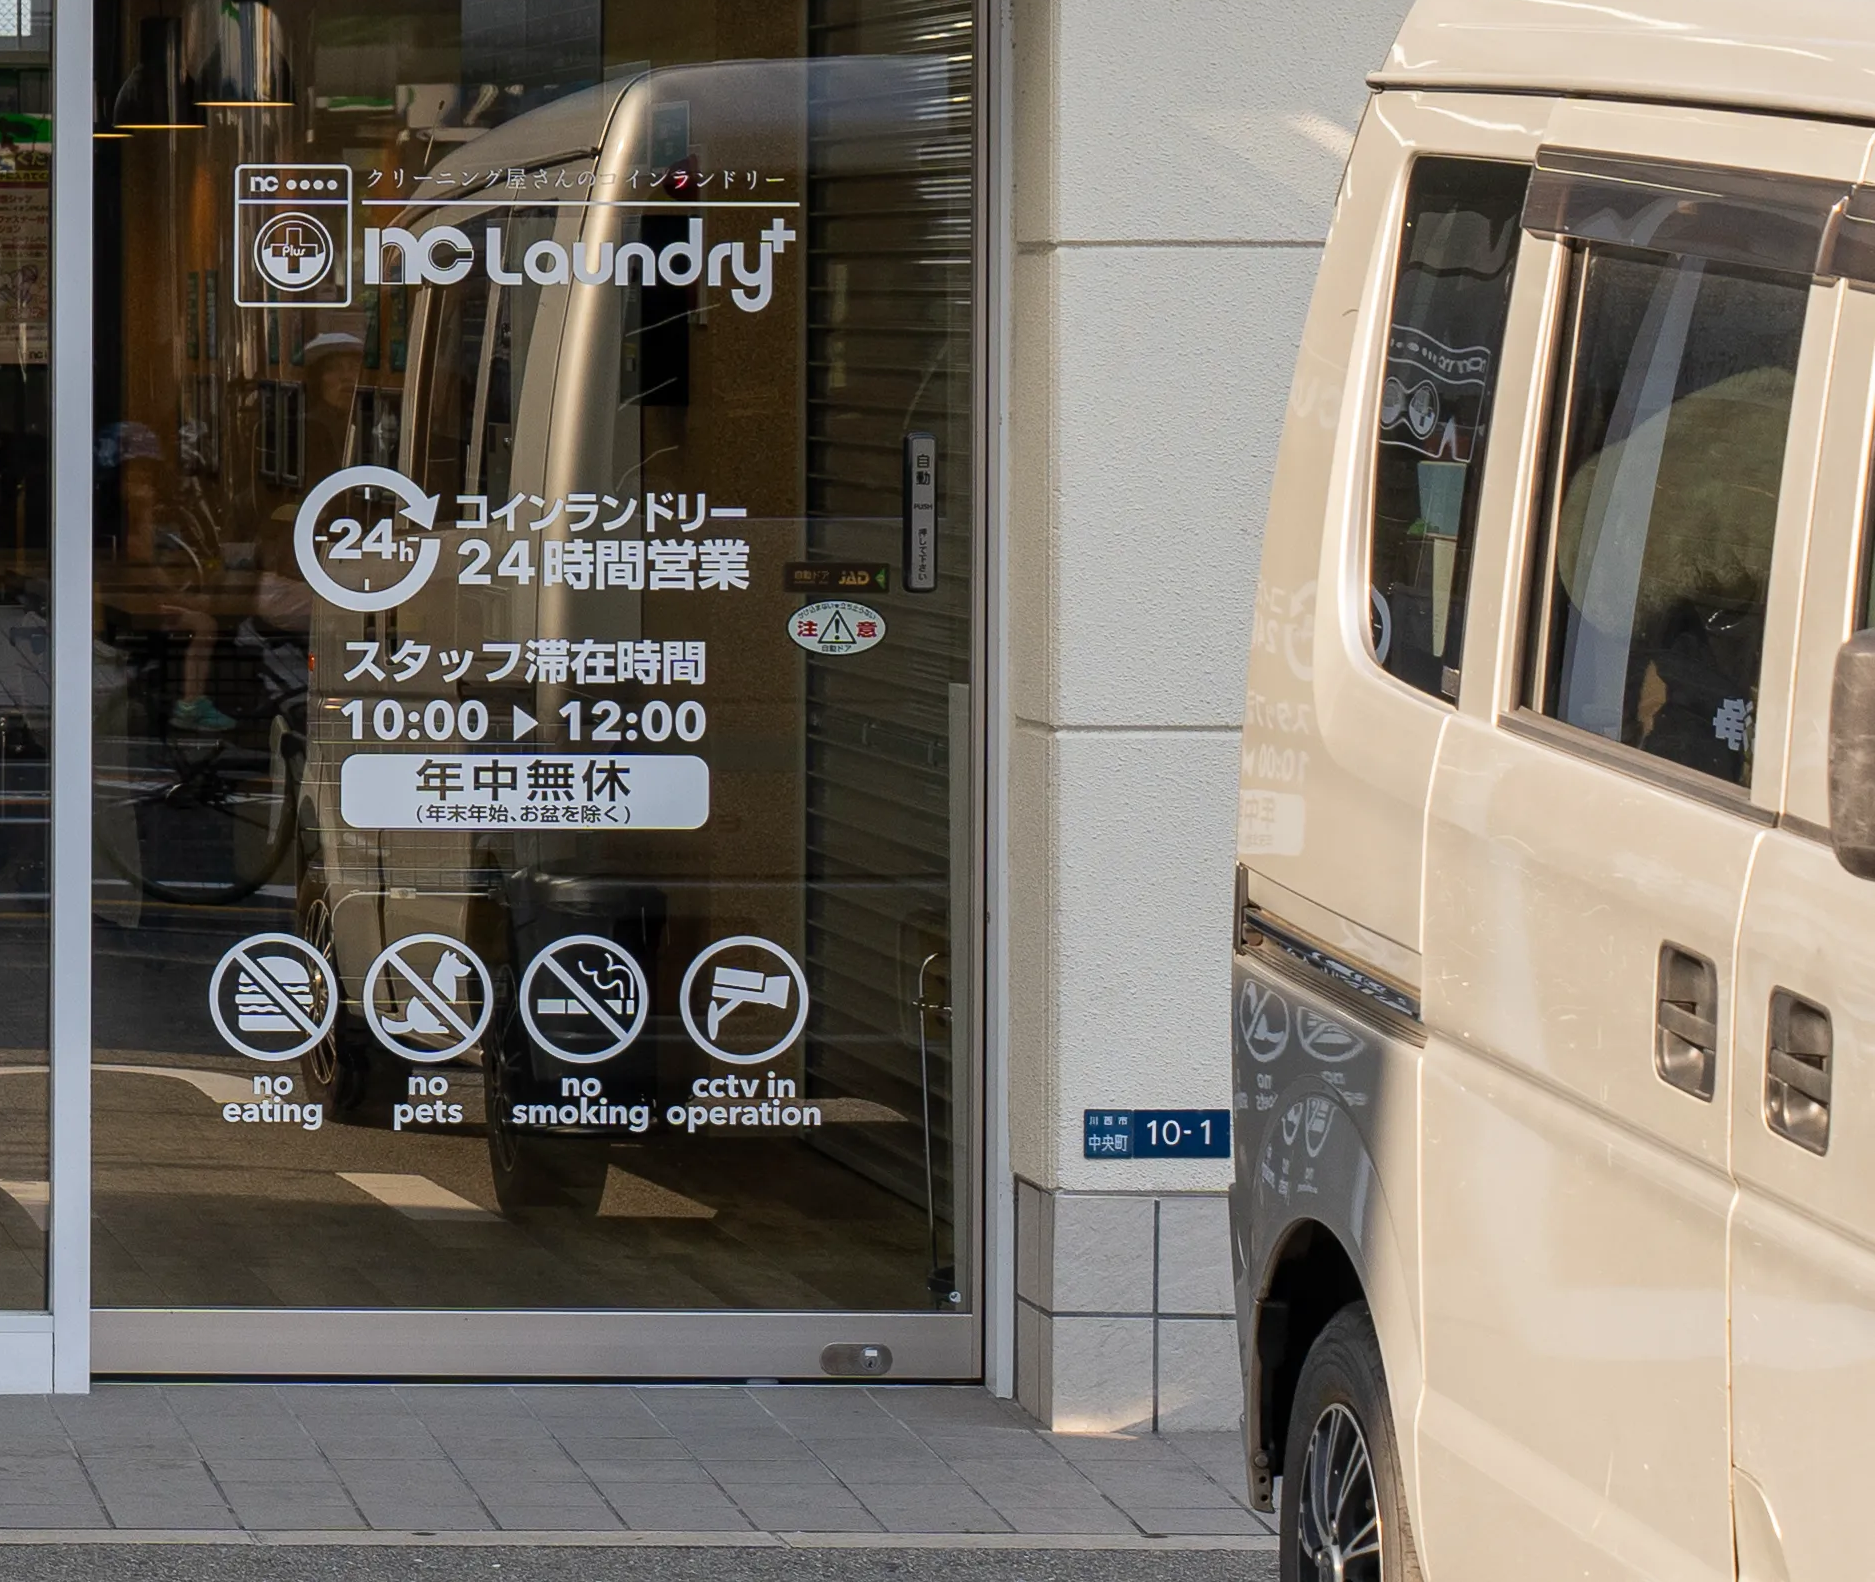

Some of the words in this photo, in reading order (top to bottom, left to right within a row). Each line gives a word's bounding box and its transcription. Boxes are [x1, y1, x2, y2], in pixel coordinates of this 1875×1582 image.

[249, 175, 279, 193] nc
[365, 166, 786, 192] クリーニング屋さんのコインランドリー
[282, 244, 306, 260] Plus
[364, 226, 474, 286] nc
[916, 453, 931, 486] 自動
[455, 492, 748, 531] コインランドリー
[913, 503, 933, 511] PUSH
[458, 538, 751, 591] 24時間営業
[796, 620, 819, 638] 注
[343, 639, 707, 686] スタッフ滞在時間
[821, 644, 852, 653] 自動ドア
[341, 699, 489, 743] 10:00
[560, 699, 707, 743] 12:00
[414, 758, 632, 802] 年中無休
[253, 1075, 294, 1096] no
[408, 1075, 449, 1096] no
[561, 1076, 602, 1097] no
[692, 1074, 761, 1099] cctv
[767, 1071, 796, 1098] in
[222, 1099, 324, 1130] eating
[393, 1099, 463, 1130] pets
[511, 1098, 650, 1132] smoking
[666, 1099, 822, 1132] operation
[1087, 1133, 1129, 1153] 中央町
[1146, 1119, 1213, 1146] 10-1
